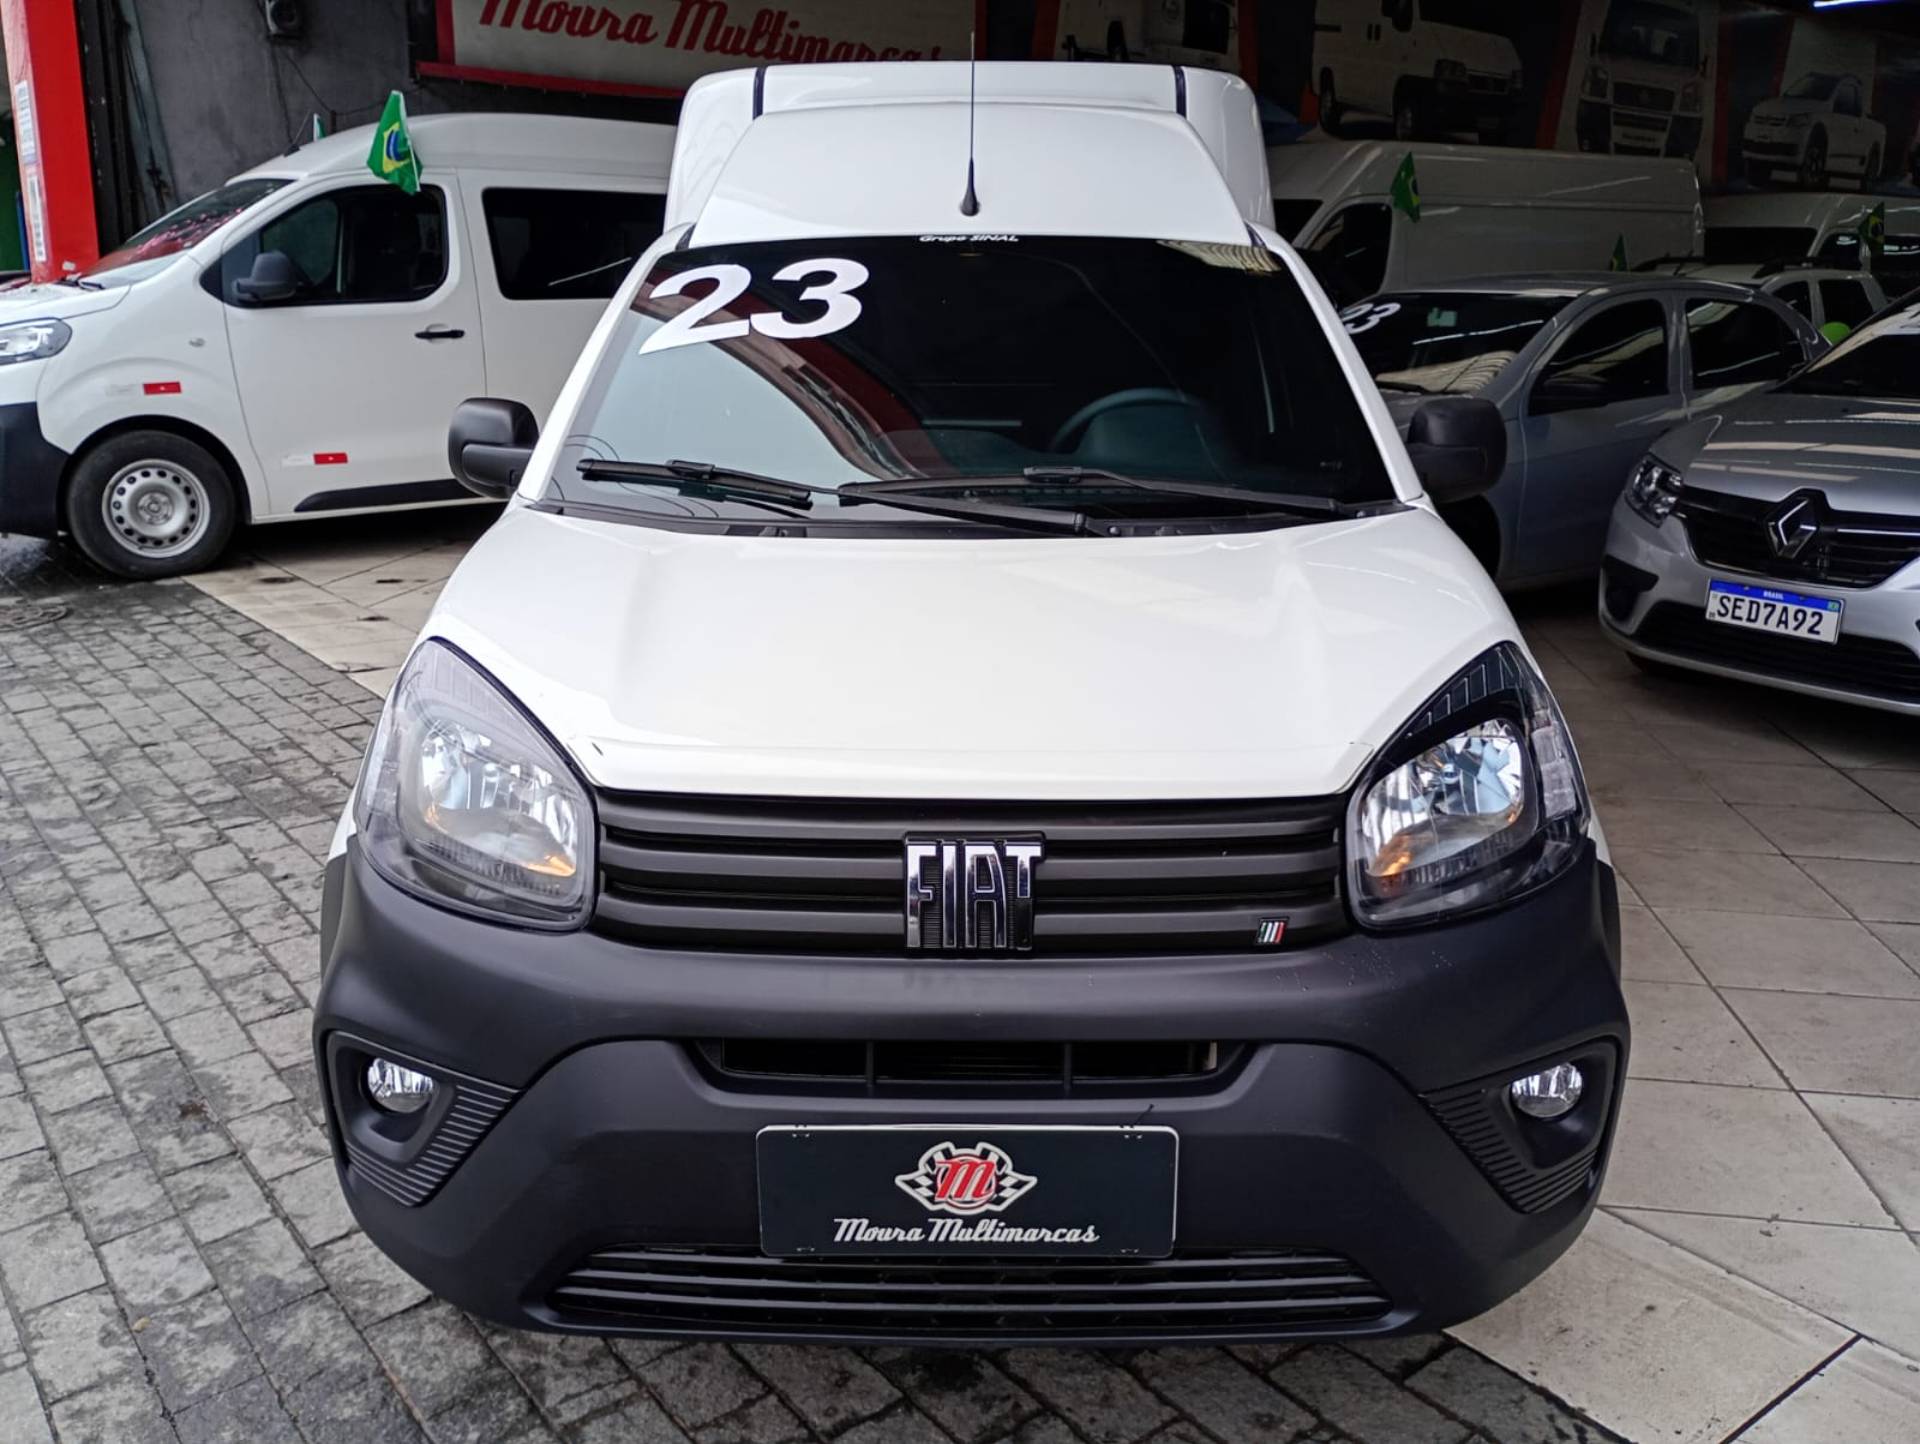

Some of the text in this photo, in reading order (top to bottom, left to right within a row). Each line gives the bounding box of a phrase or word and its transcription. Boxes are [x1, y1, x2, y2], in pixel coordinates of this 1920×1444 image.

[969, 234, 1019, 242] SINAL
[639, 258, 870, 355] 23
[1716, 595, 1824, 636] SED7A92
[905, 842, 1043, 950] FIAT
[833, 1218, 1100, 1244] Moura Multimarcas
